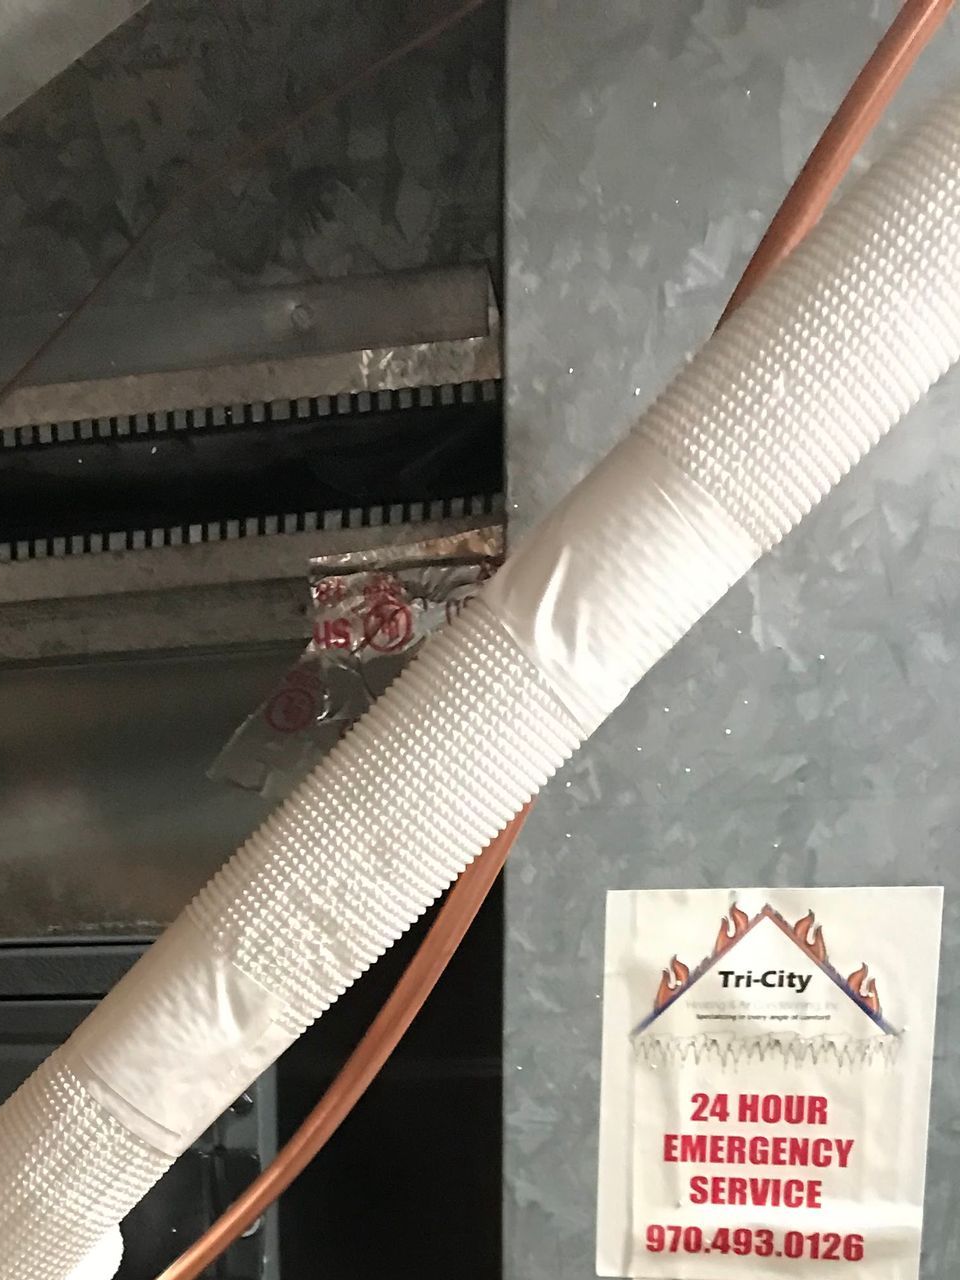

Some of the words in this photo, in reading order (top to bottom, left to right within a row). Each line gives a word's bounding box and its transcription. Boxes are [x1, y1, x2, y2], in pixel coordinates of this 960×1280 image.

[718, 969, 813, 994] Tri-City
[690, 1093, 730, 1123] 24
[738, 1093, 829, 1125] HOUR
[663, 1134, 855, 1168] EMERGENCY
[689, 1175, 823, 1209] SERVICE
[645, 1224, 865, 1262] 970.493.0126
